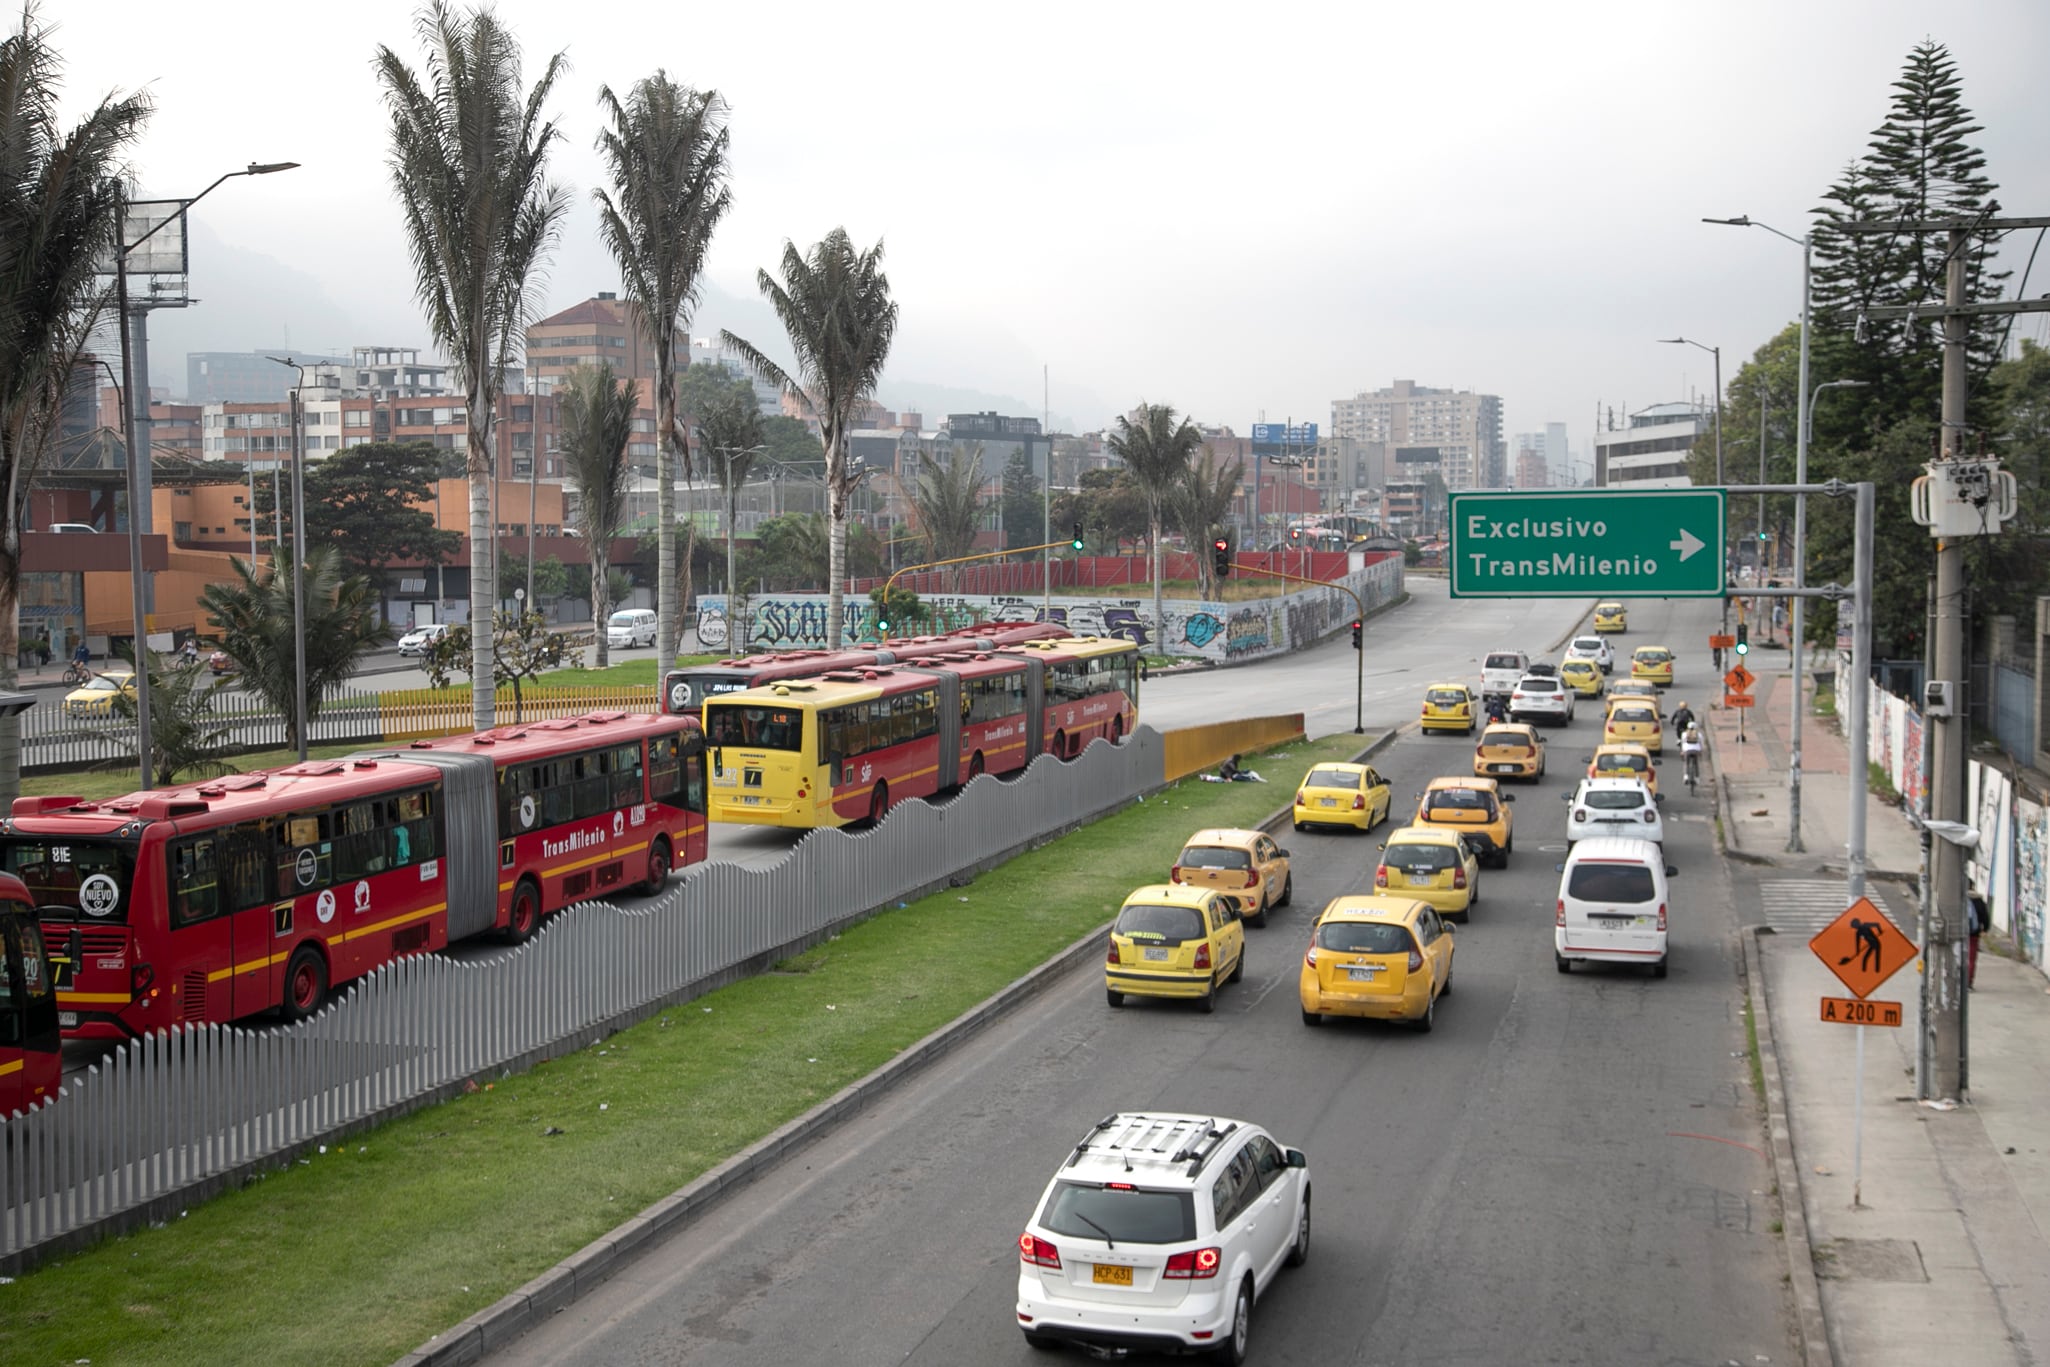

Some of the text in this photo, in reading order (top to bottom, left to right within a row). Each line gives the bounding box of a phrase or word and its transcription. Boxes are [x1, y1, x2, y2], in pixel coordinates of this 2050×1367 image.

[1468, 515, 1608, 539] Exclusivo
[1469, 553, 1658, 577] TransMilenio
[543, 827, 605, 858] TransMilenio
[86, 889, 112, 901] NUEVO
[1826, 1002, 1897, 1022] A 200 m
